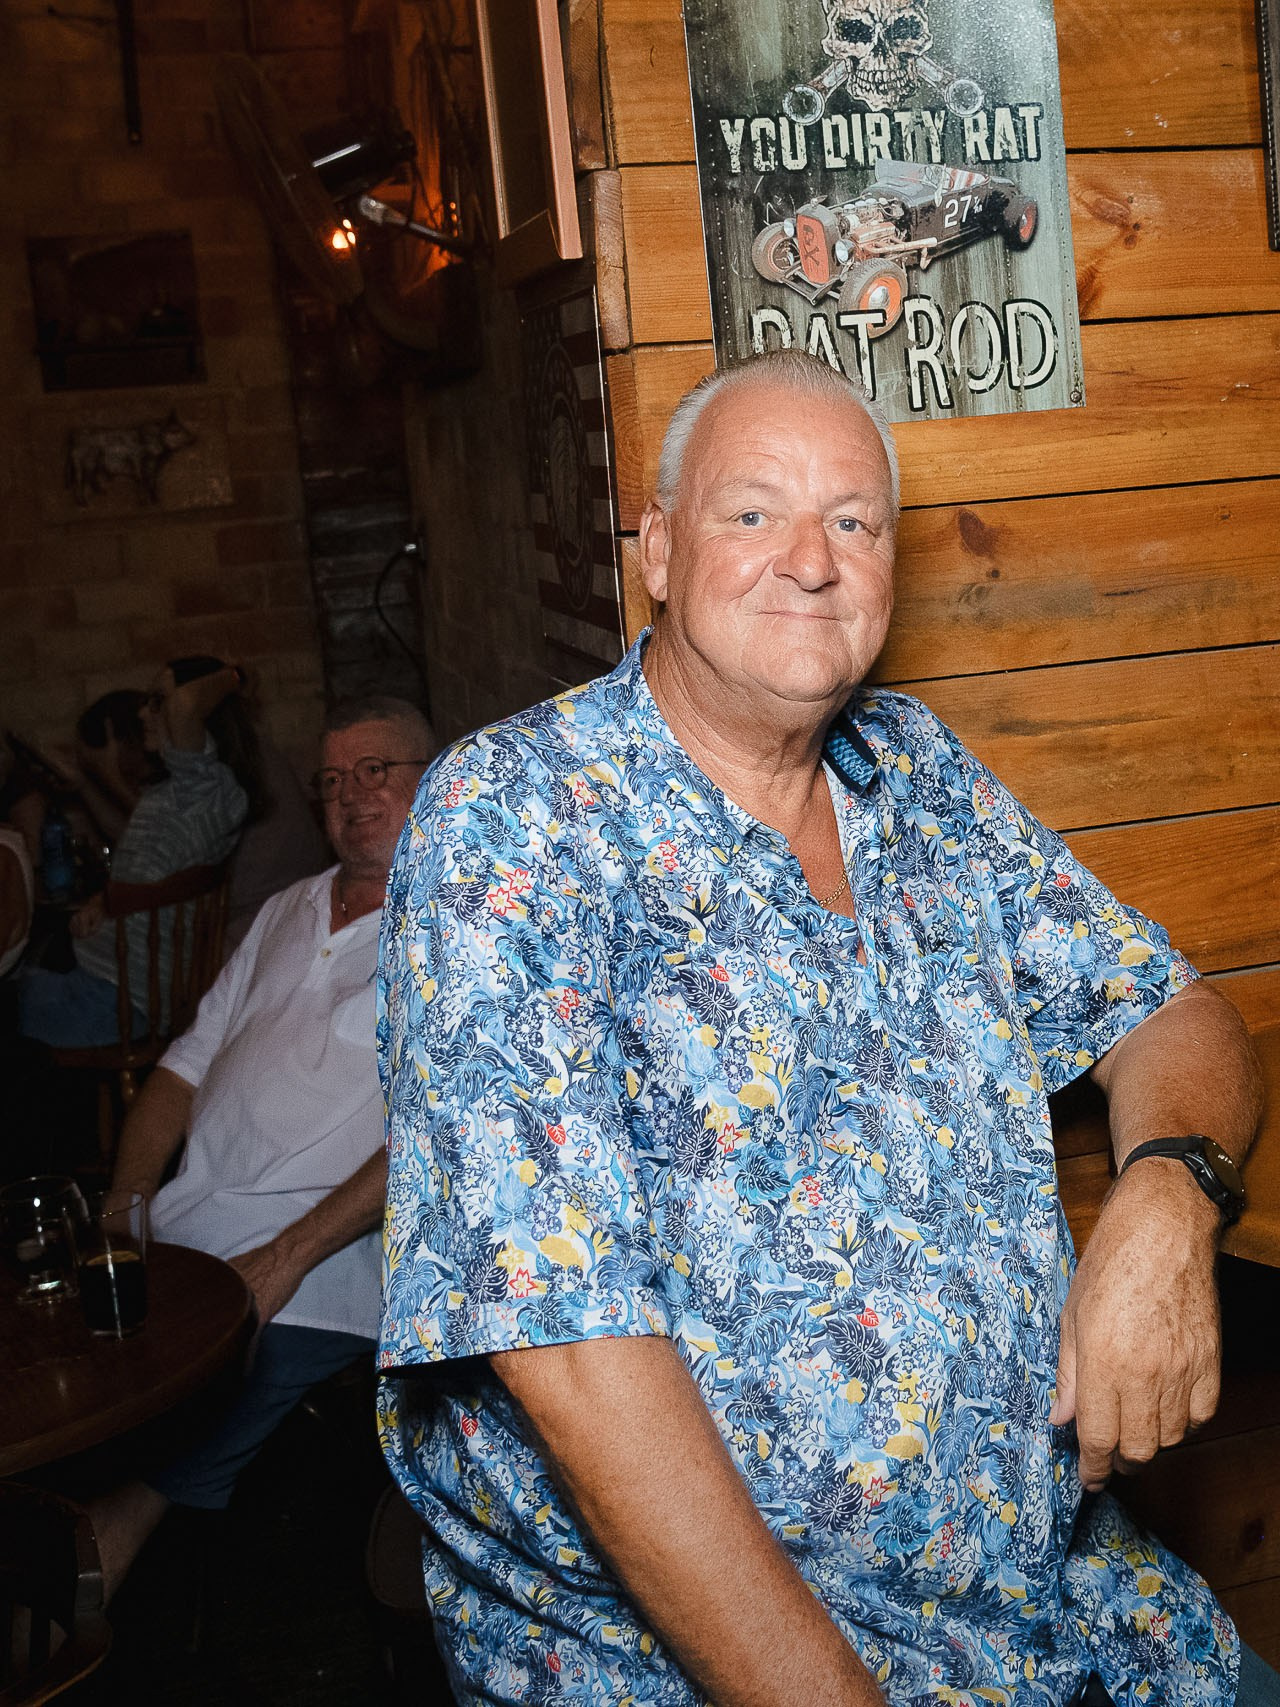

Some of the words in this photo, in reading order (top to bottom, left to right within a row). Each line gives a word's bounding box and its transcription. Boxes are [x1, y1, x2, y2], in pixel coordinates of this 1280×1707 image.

[719, 117, 808, 173] YOU
[825, 109, 946, 168] DIRTY
[965, 104, 1041, 162] RAT
[904, 296, 1056, 410] ROD
